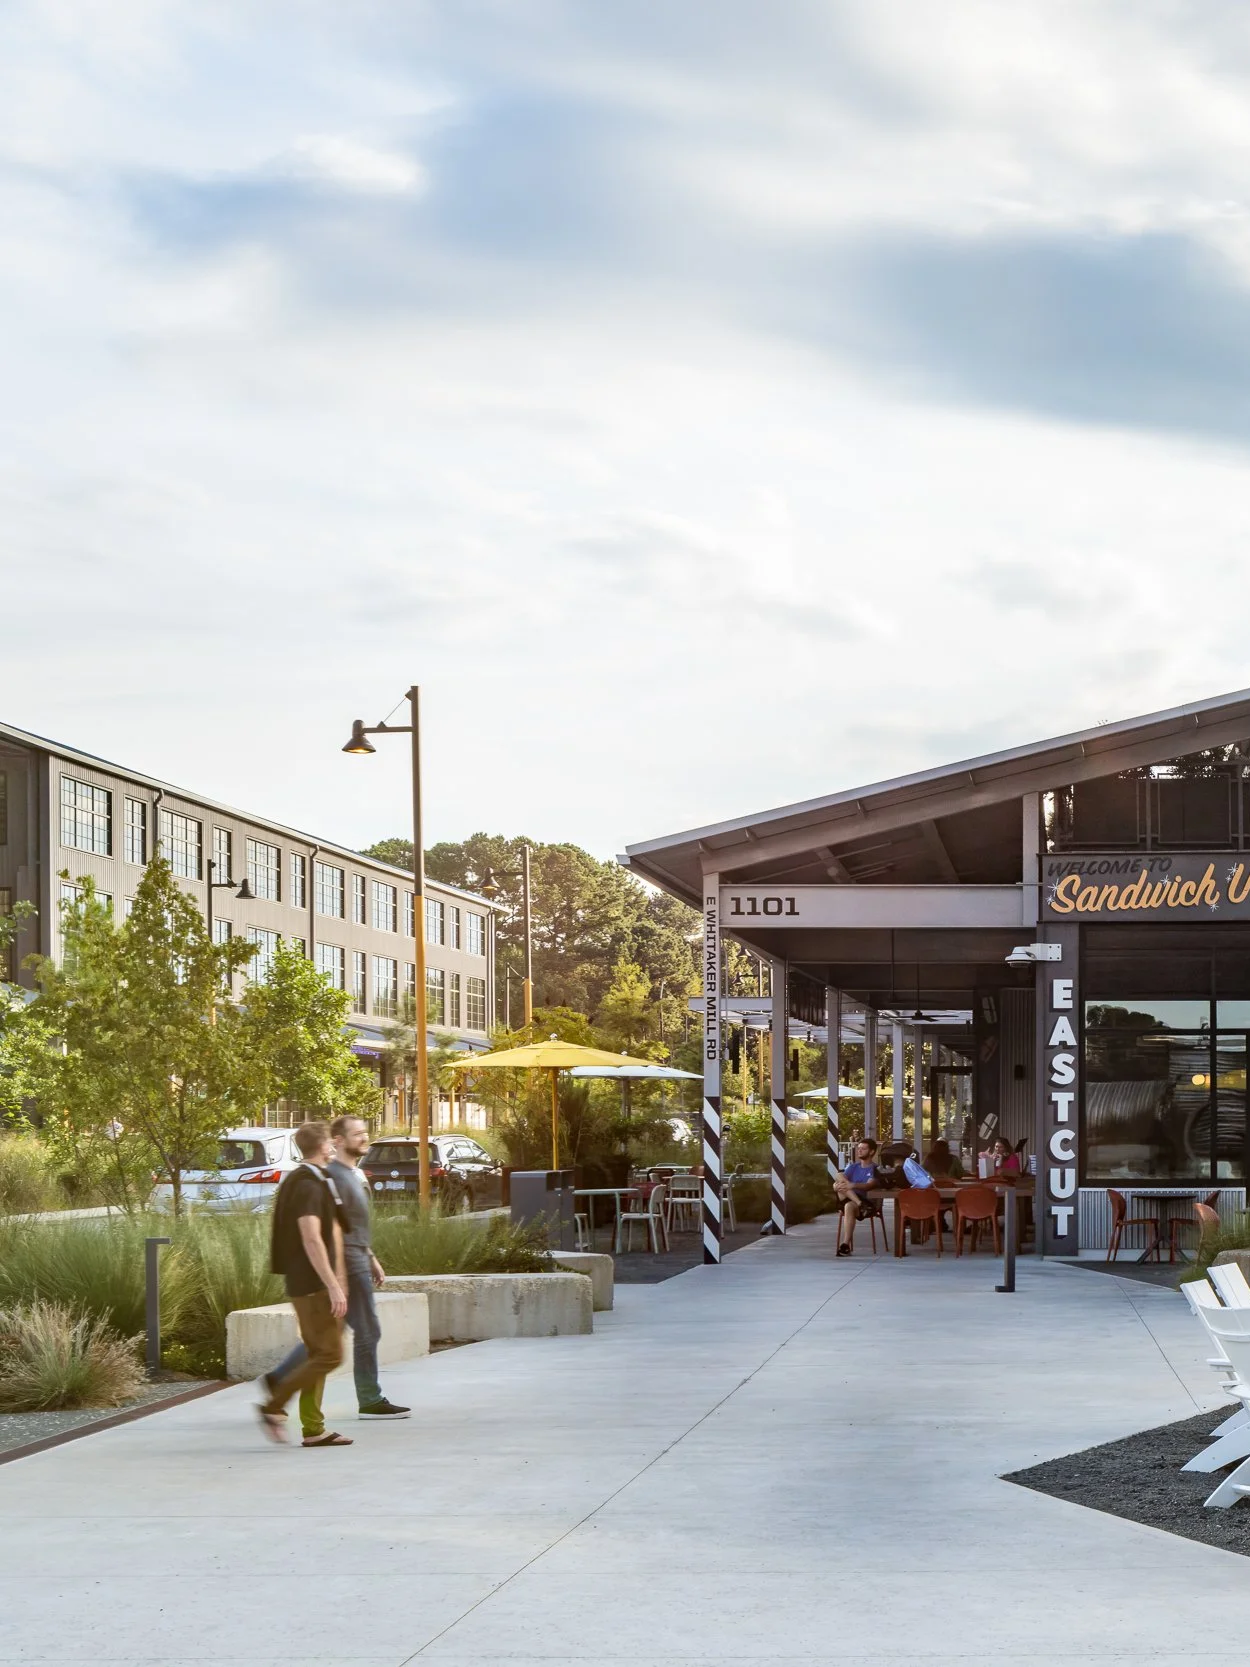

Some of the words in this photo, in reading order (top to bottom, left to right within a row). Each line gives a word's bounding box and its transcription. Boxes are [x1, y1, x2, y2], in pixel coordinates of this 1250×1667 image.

[1048, 859, 1140, 877] WELCOME
[1149, 857, 1173, 873] TO
[706, 897, 716, 906] E
[1051, 863, 1220, 914] Sandwich
[731, 897, 799, 915] 1101
[706, 909, 717, 993] WHITAKER
[706, 996, 717, 1035] MILL
[706, 1039, 717, 1061] RD
[1049, 979, 1078, 1236] EASTCUT
